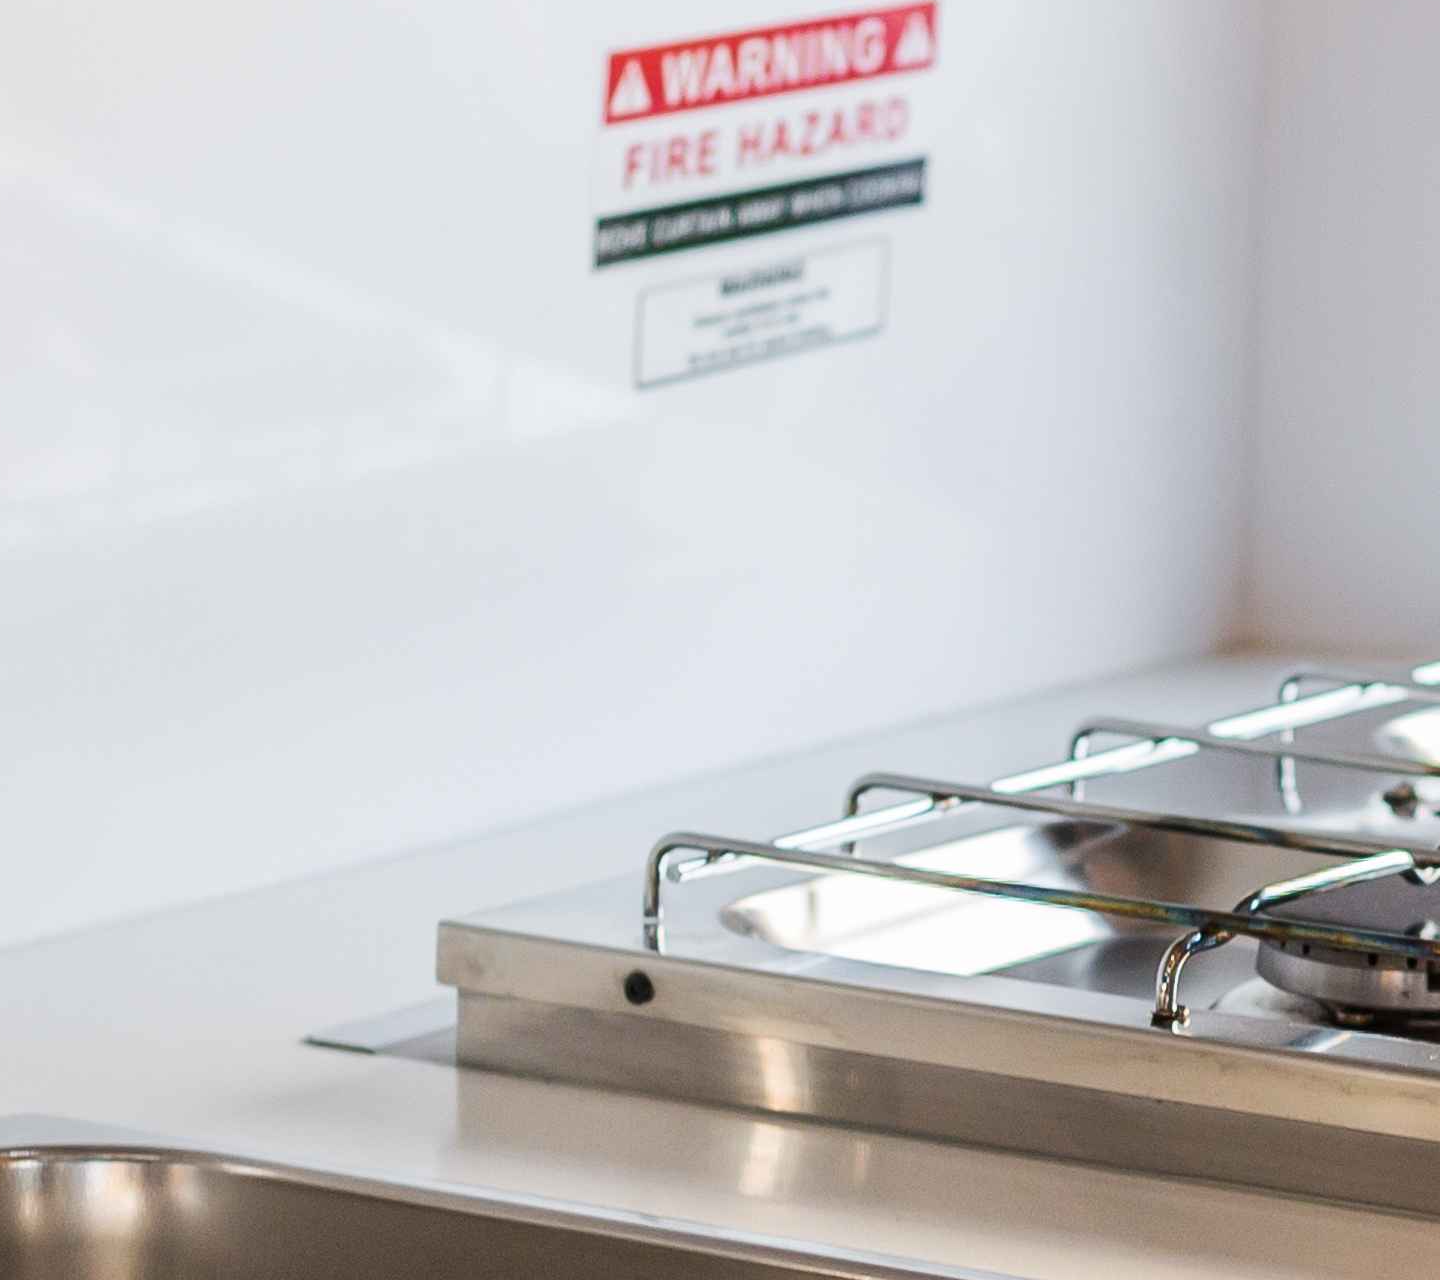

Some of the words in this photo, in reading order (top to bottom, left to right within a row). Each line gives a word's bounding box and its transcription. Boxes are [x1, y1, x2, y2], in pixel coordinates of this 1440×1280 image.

[662, 17, 886, 106] WARNING
[623, 129, 719, 191] FIRE
[737, 96, 910, 170] HAZARD
